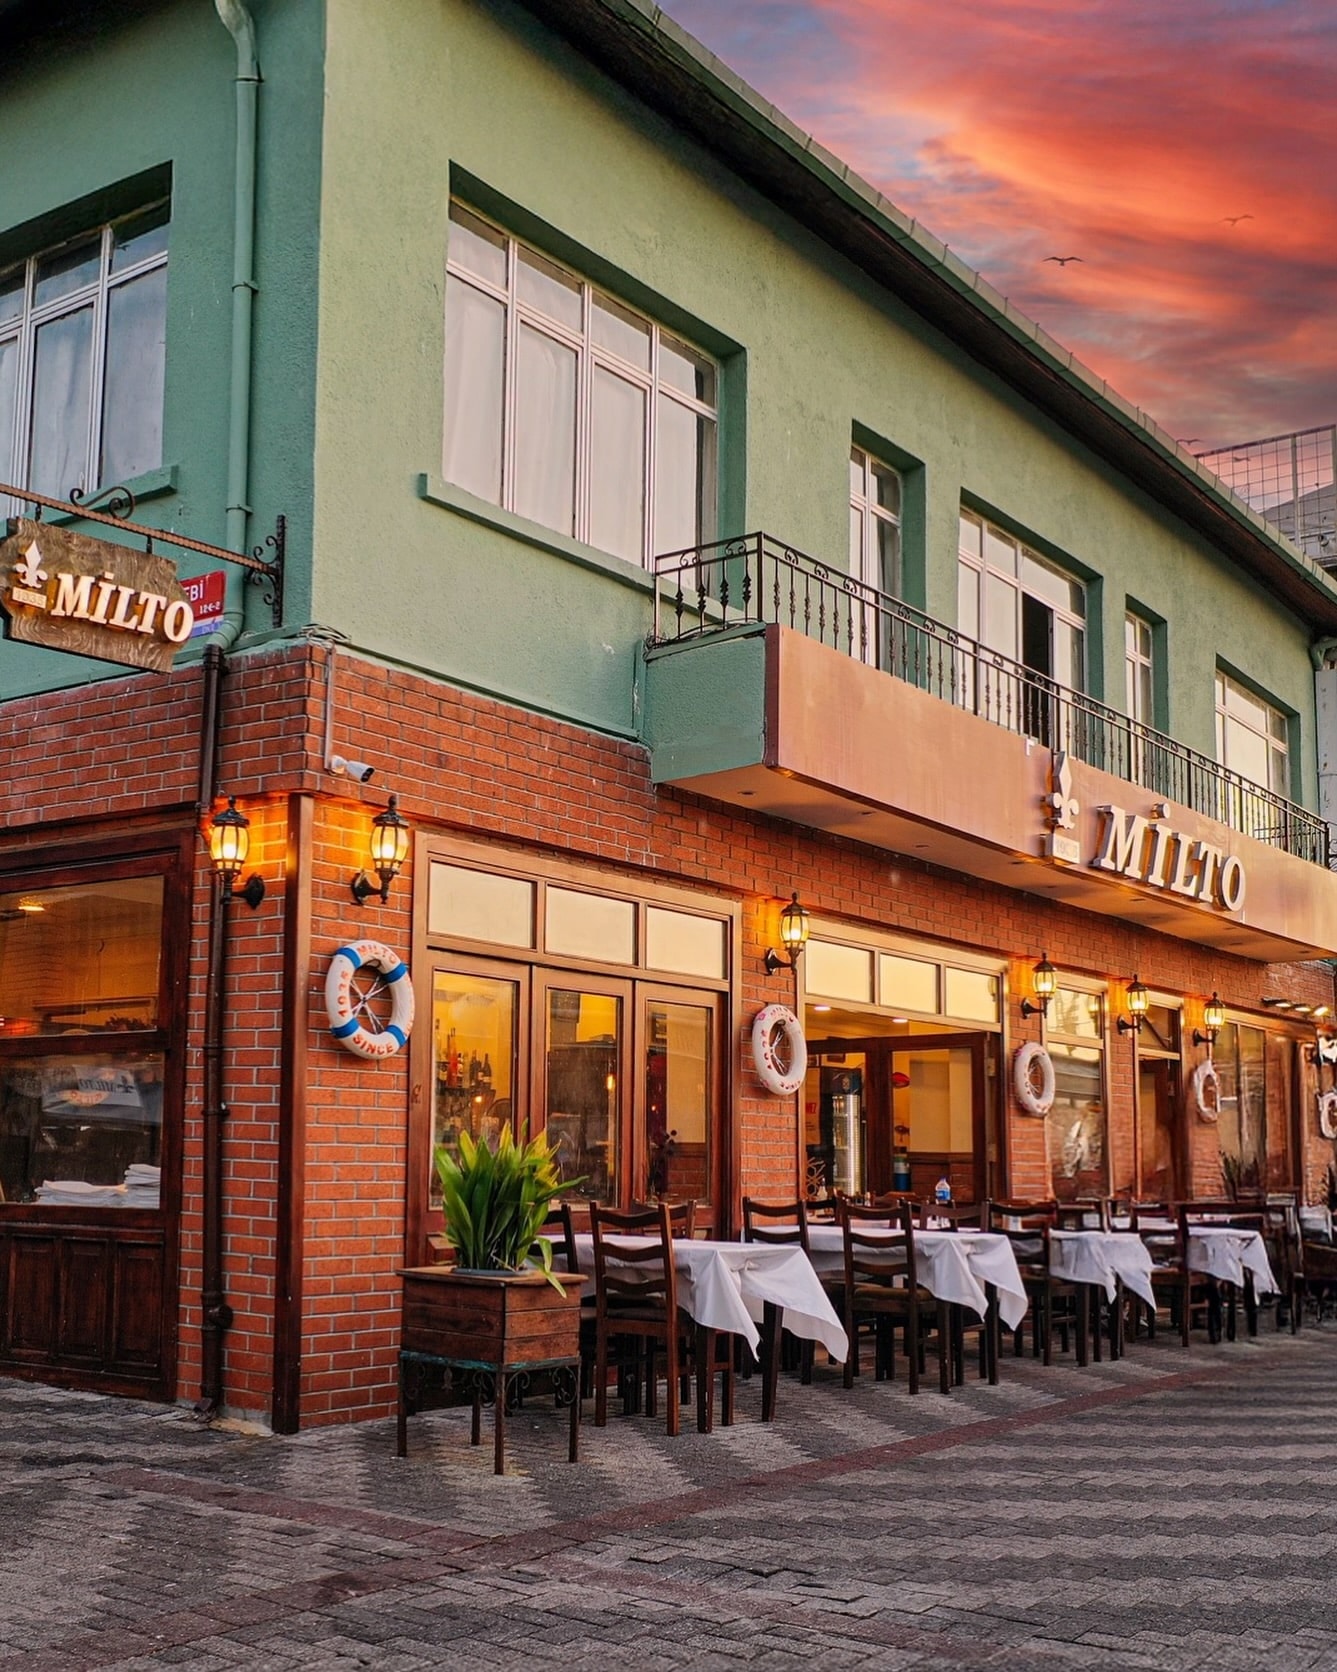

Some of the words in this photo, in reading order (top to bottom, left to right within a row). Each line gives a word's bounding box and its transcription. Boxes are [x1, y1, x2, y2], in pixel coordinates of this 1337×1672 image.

[50, 571, 194, 642] MİLTO
[1097, 803, 1246, 912] MİLTO
[352, 1034, 394, 1055] SINCE
